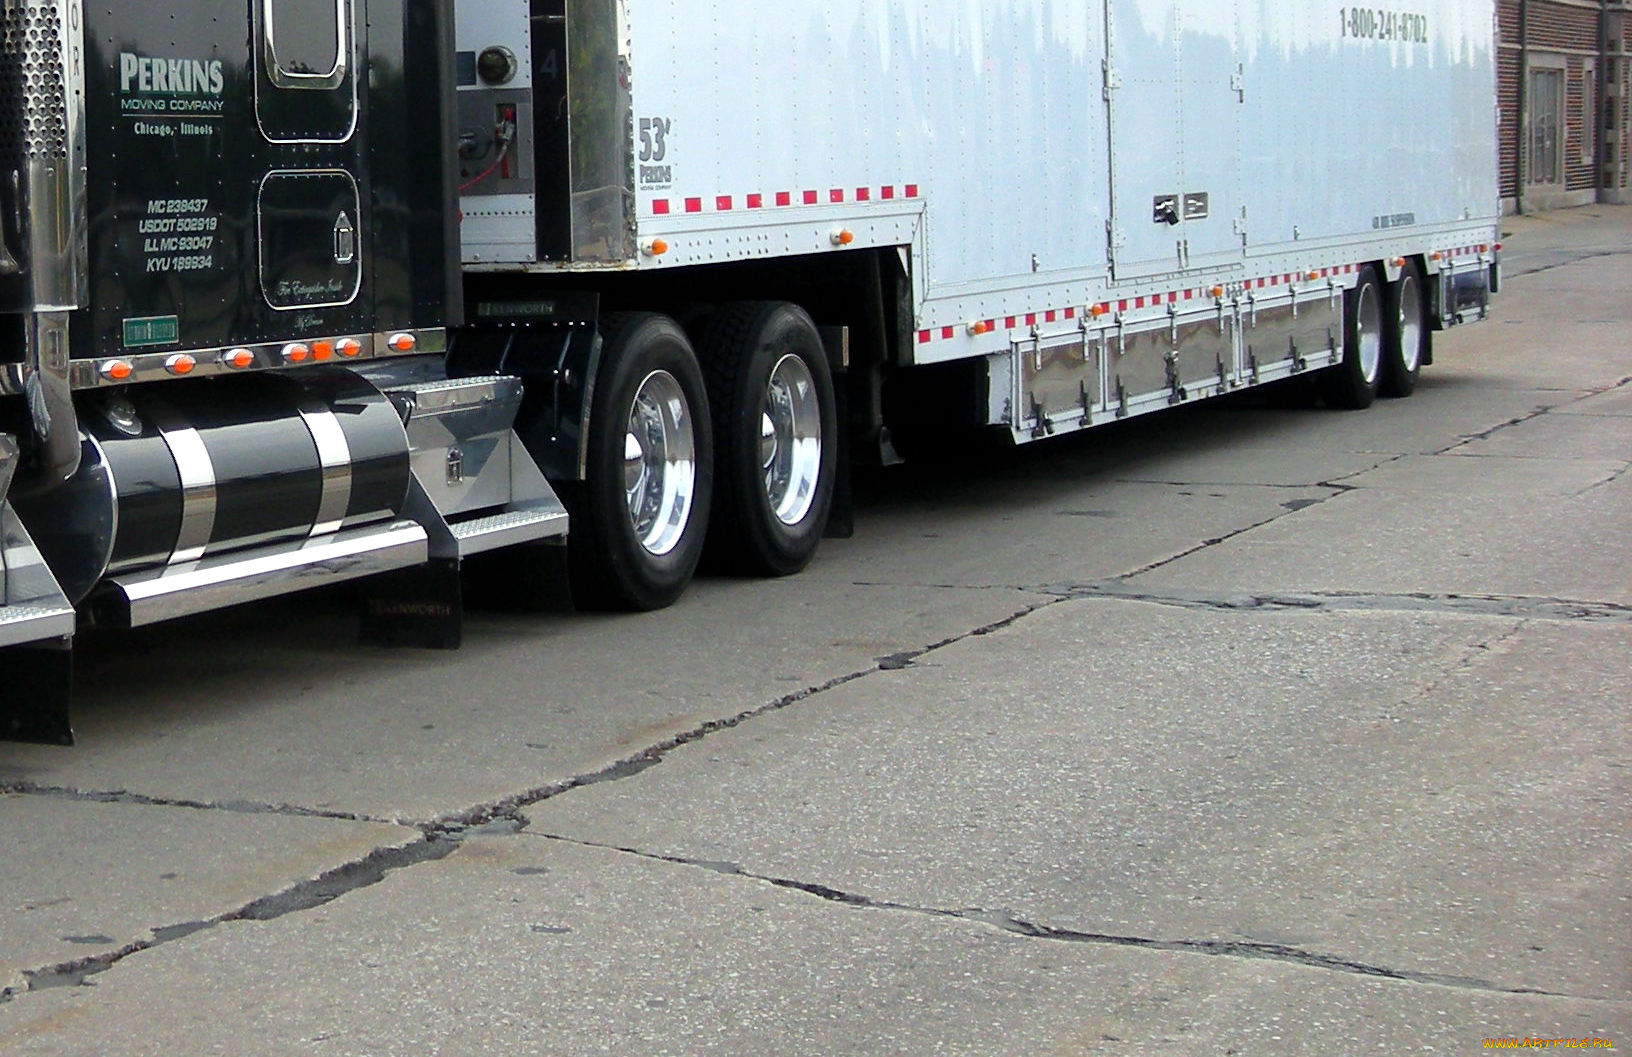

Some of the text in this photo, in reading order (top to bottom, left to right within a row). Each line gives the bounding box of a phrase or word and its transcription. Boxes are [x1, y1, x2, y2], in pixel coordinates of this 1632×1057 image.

[1339, 6, 1428, 44] 1-800-241-8702
[120, 52, 224, 94] PERKINS
[121, 98, 224, 111] MOVING COMPANY
[134, 122, 214, 137] Chicago, Illinois
[638, 117, 671, 162] 53'
[639, 164, 672, 183] PERKINS
[147, 200, 166, 214] MC
[139, 218, 176, 233] USDOT
[144, 238, 159, 253] ILL
[160, 237, 179, 251] MC
[146, 257, 171, 273] KYU
